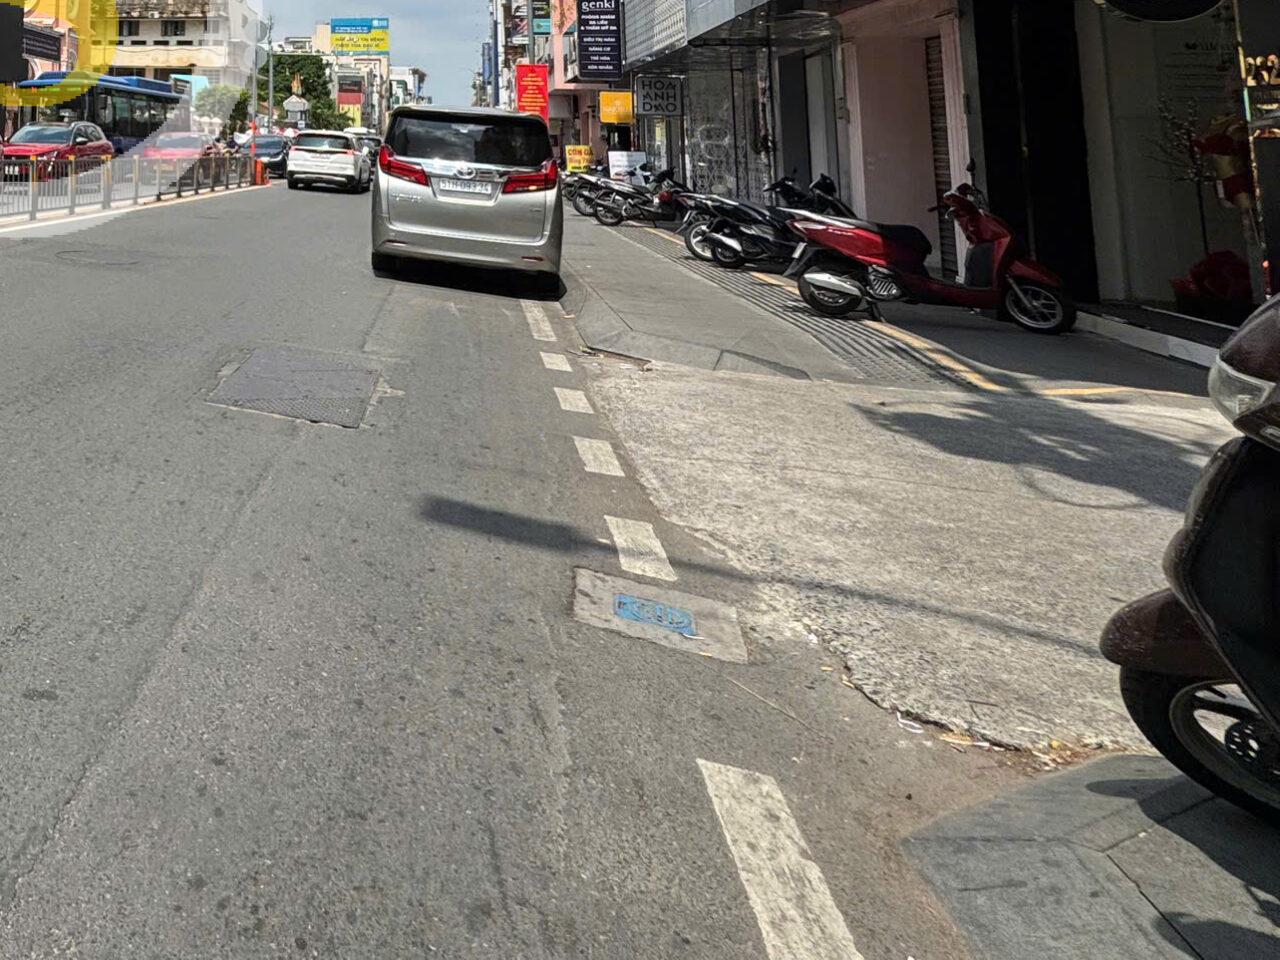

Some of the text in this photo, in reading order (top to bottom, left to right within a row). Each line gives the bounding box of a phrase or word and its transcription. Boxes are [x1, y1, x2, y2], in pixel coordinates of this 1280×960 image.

[581, 0, 615, 13] genki
[642, 80, 676, 91] HOA
[642, 91, 676, 102] ANH
